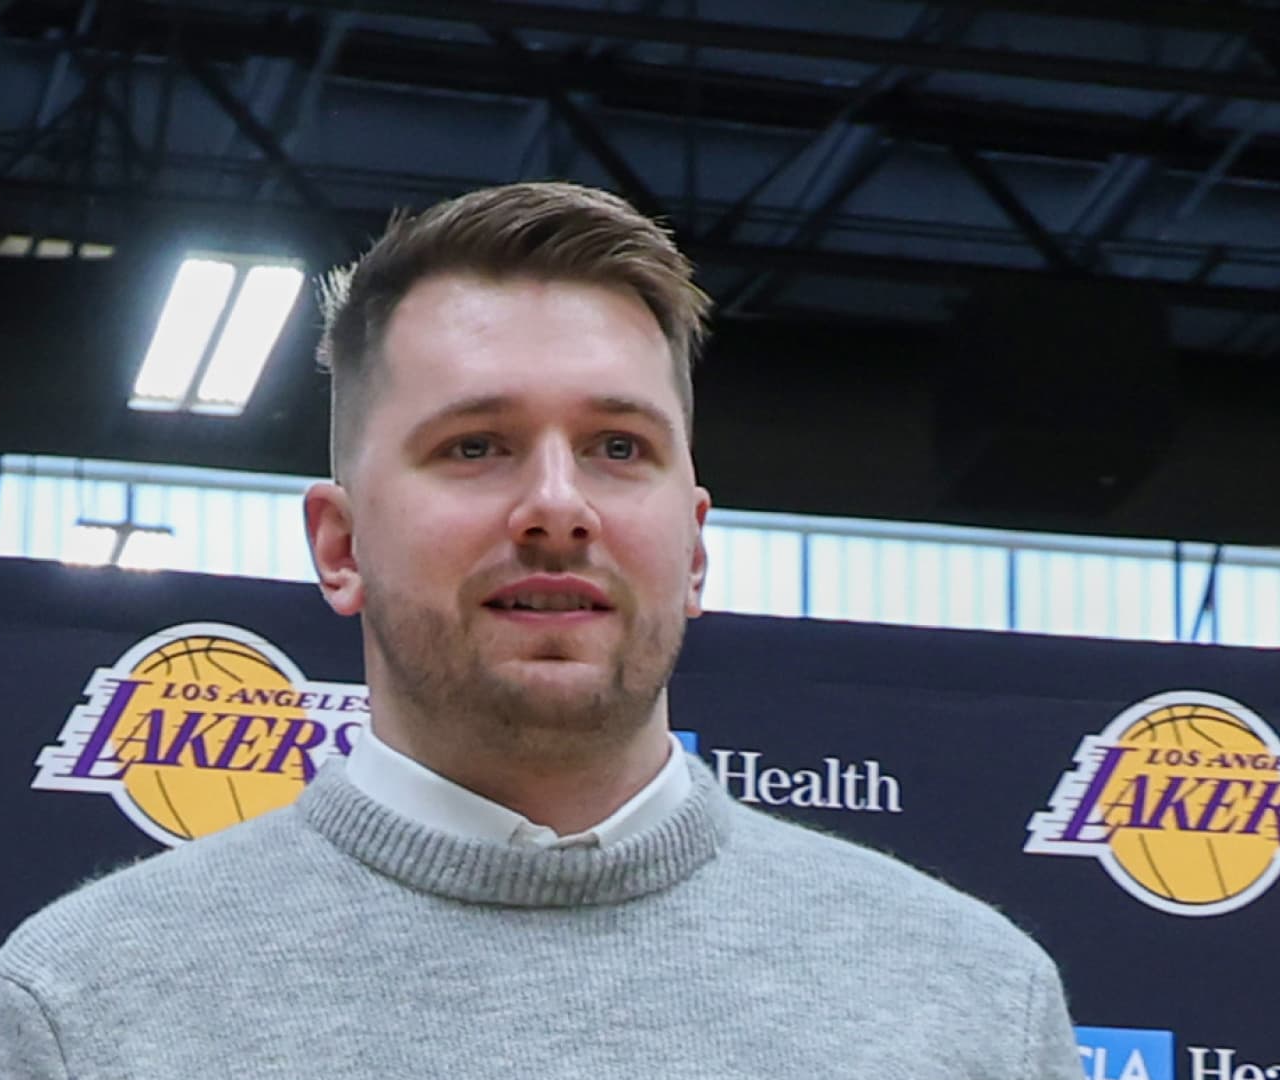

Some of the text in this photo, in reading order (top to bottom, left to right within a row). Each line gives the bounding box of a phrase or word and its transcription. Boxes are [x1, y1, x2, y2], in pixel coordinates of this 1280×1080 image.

[161, 681, 220, 702] LOS
[1144, 747, 1201, 767] LOS
[711, 748, 904, 812] Health
